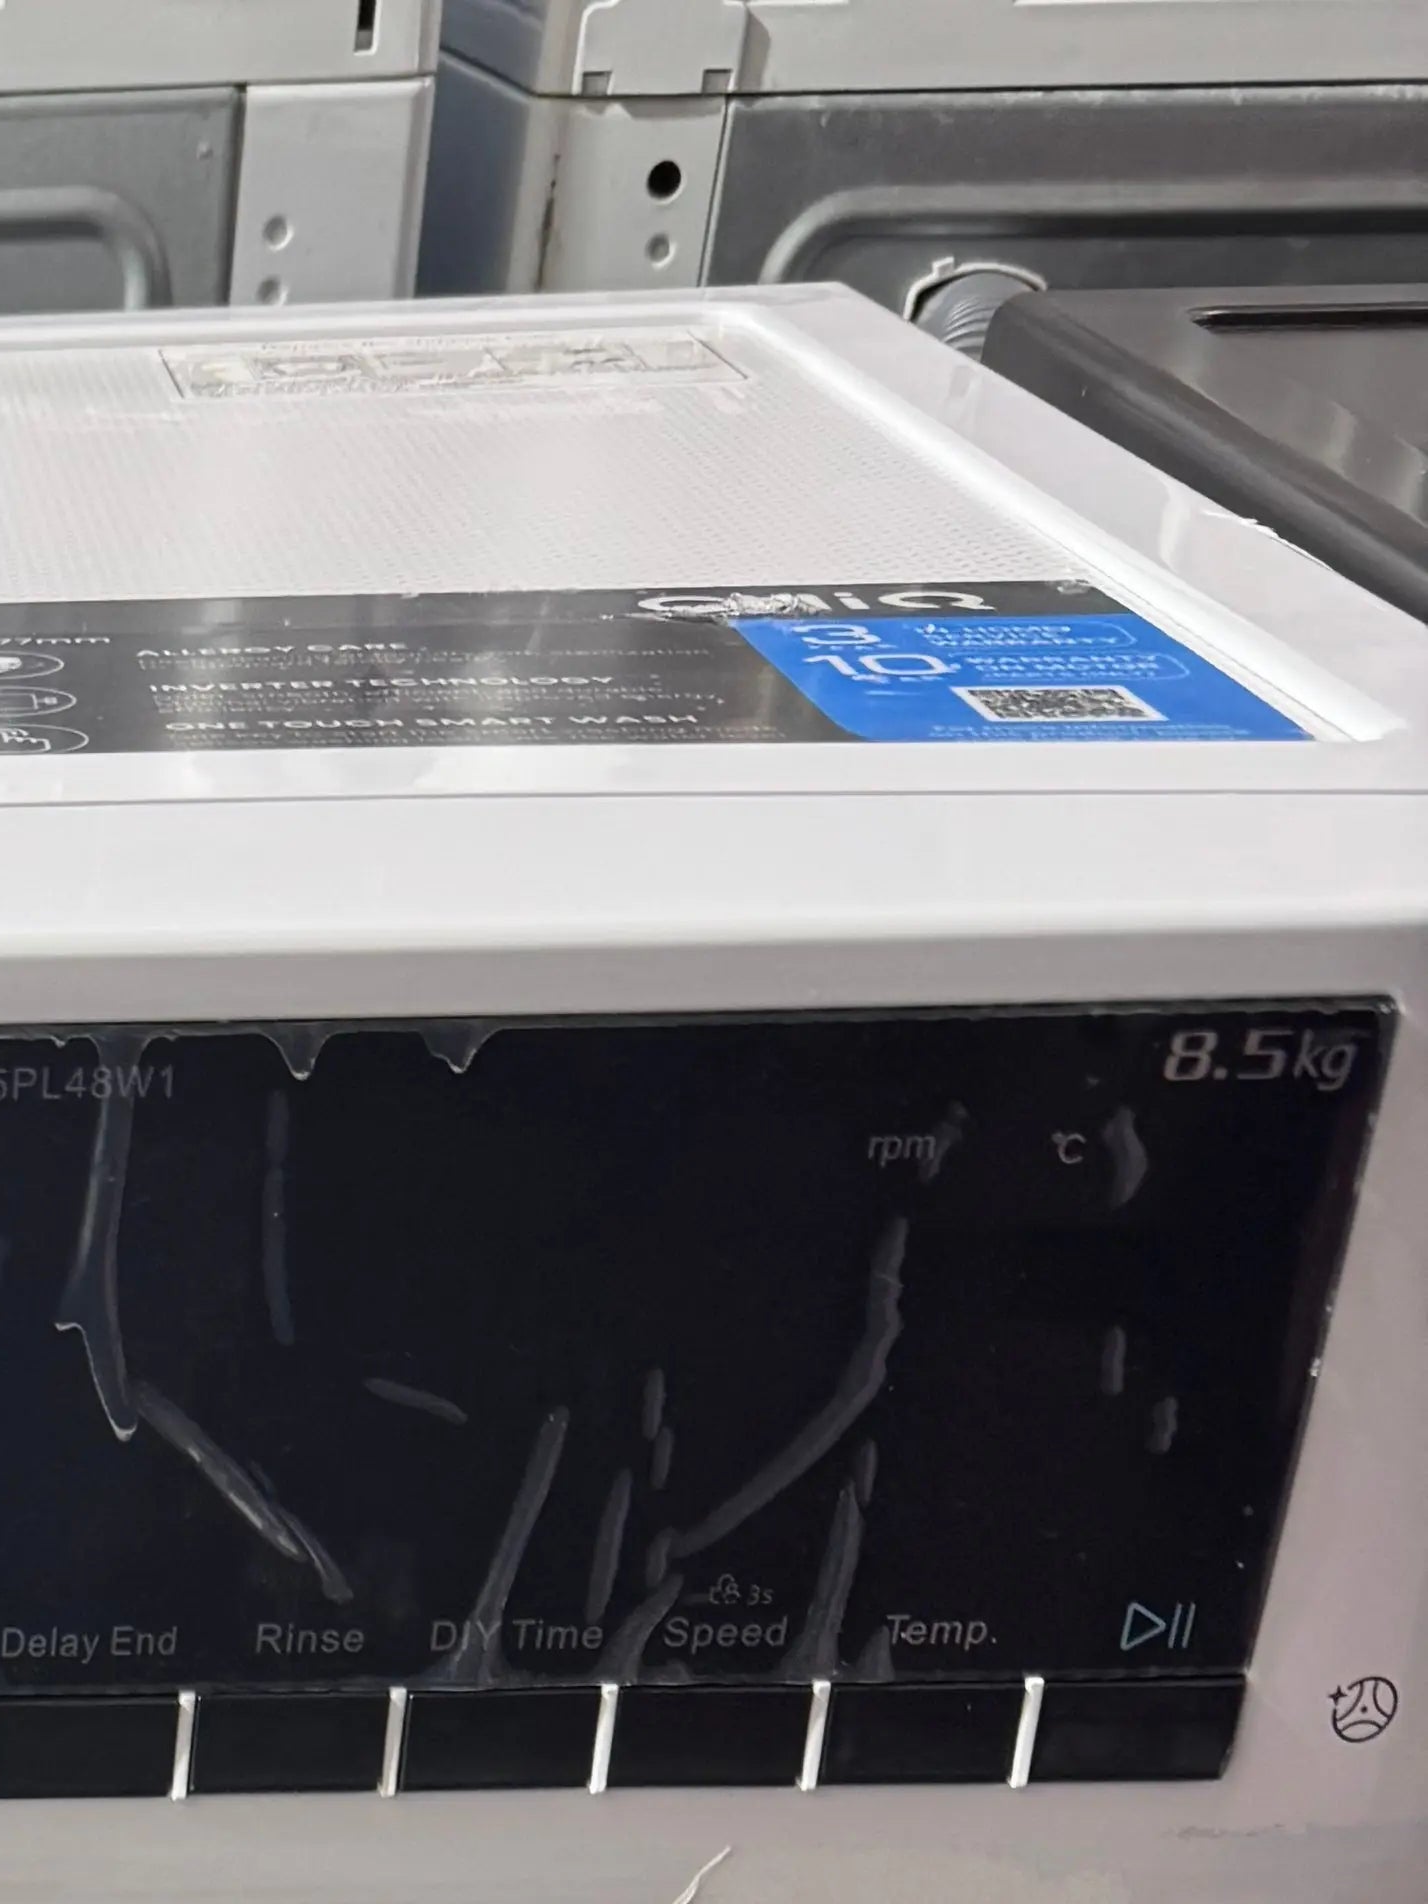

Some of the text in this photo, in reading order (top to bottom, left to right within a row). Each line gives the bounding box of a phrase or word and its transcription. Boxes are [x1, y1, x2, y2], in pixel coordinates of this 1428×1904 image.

[794, 624, 882, 645] 3
[932, 638, 1118, 648] WARRANTY
[136, 643, 406, 657] ALLERGY CARE
[964, 655, 1158, 664] WARRANTY
[802, 654, 956, 675] 10
[976, 662, 1159, 672] ON MOTOR
[149, 676, 613, 692] INVERTER TECHNOLOGY
[165, 714, 698, 731] ONE TOUCH SMART WASH
[866, 1132, 936, 1169] rpm
[1, 1625, 179, 1663] Delay End
[255, 1623, 365, 1654] Rinse
[513, 1619, 604, 1650] Time
[664, 1615, 789, 1655] Speed
[887, 1615, 997, 1652] Temp.
